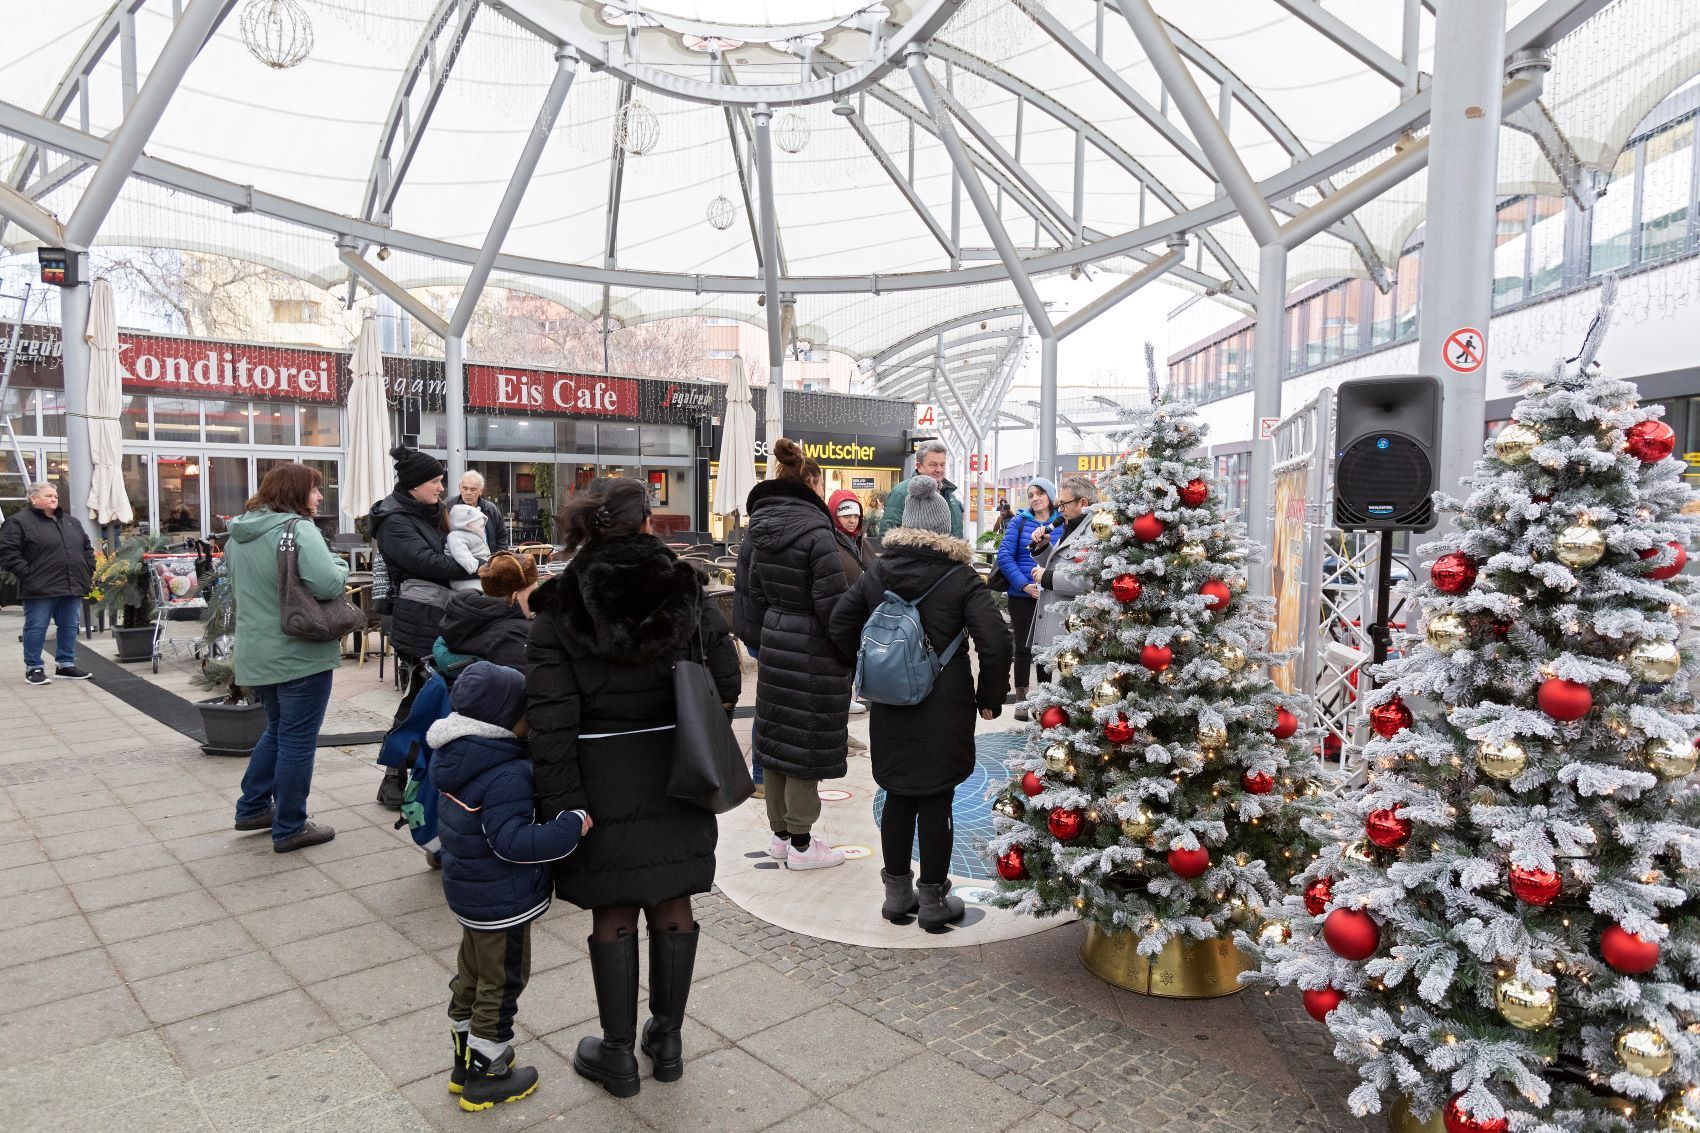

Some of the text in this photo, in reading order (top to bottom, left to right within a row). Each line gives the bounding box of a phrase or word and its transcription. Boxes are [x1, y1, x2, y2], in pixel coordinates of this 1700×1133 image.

[0, 333, 63, 358] aredo
[496, 374, 618, 411] Eis Cafe
[804, 441, 876, 461] wutscher
